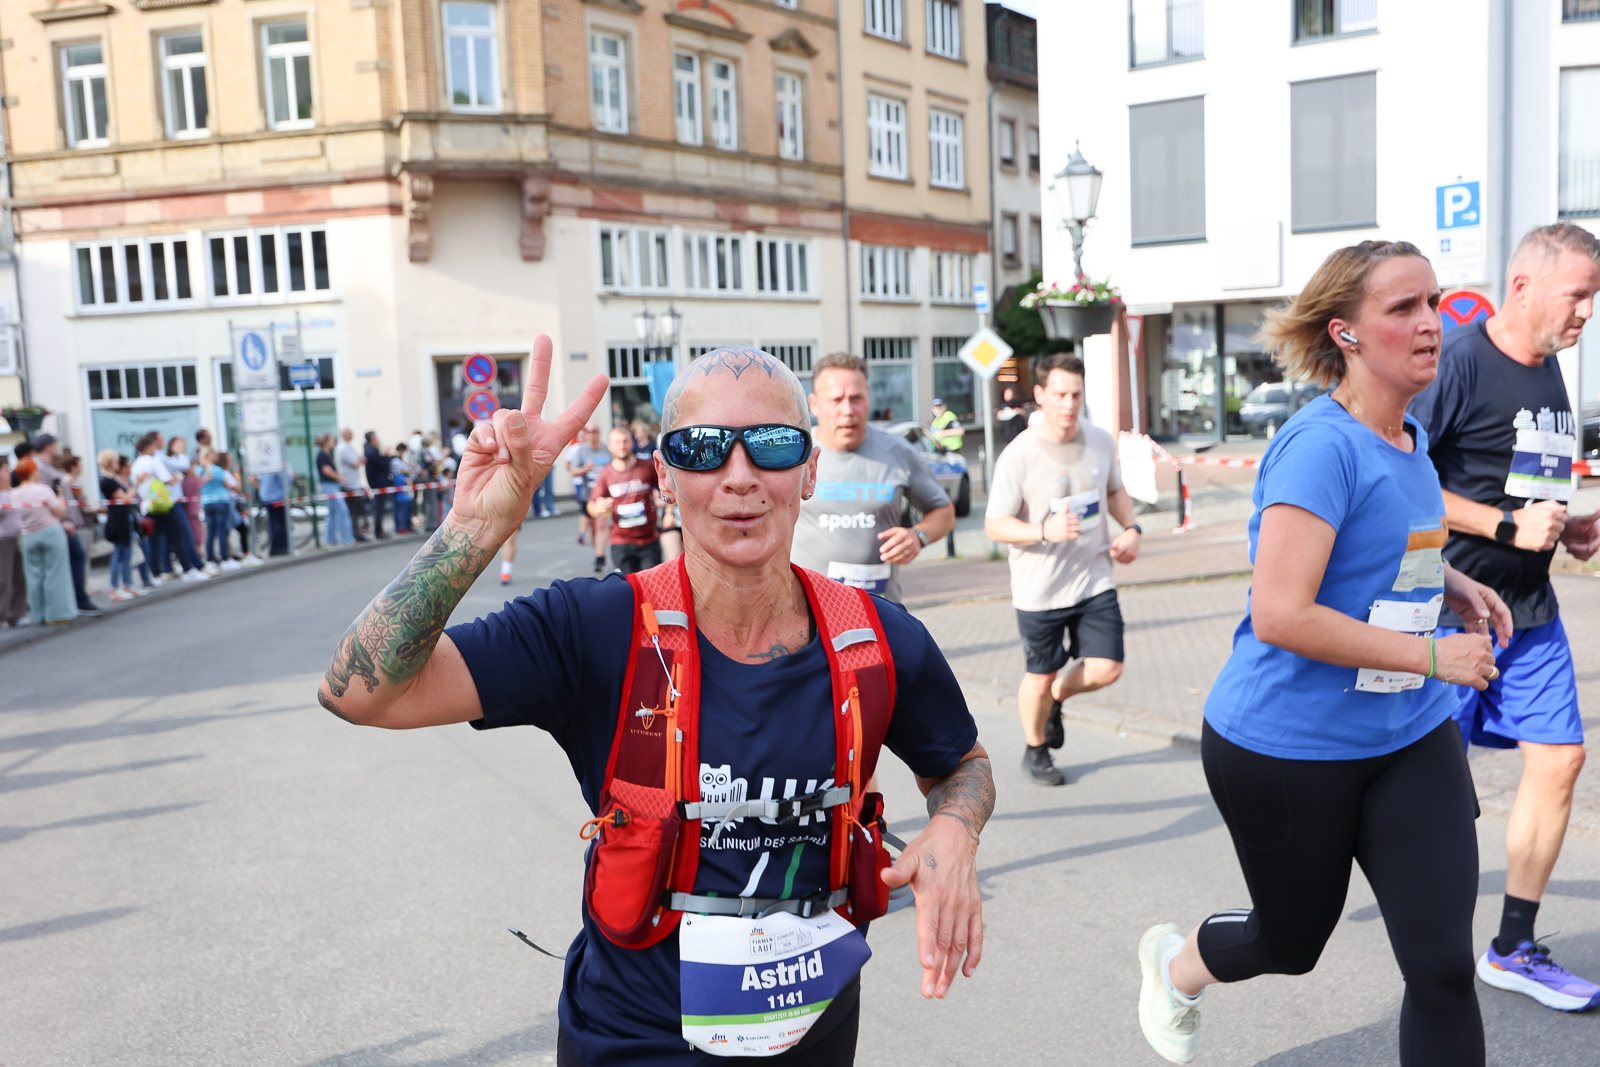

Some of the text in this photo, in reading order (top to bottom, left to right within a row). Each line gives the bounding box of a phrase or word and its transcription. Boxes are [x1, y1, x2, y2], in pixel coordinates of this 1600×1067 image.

[1443, 185, 1473, 227] P
[815, 481, 894, 502] ESTO
[818, 512, 876, 533] sports
[764, 836, 786, 849] DES
[752, 936, 773, 945] FIRMEN
[752, 944, 773, 953] LAUF
[741, 949, 824, 991] Astrid
[767, 989, 804, 1009] 1141
[711, 1033, 726, 1041] dm
[787, 1026, 807, 1036] BOSCH
